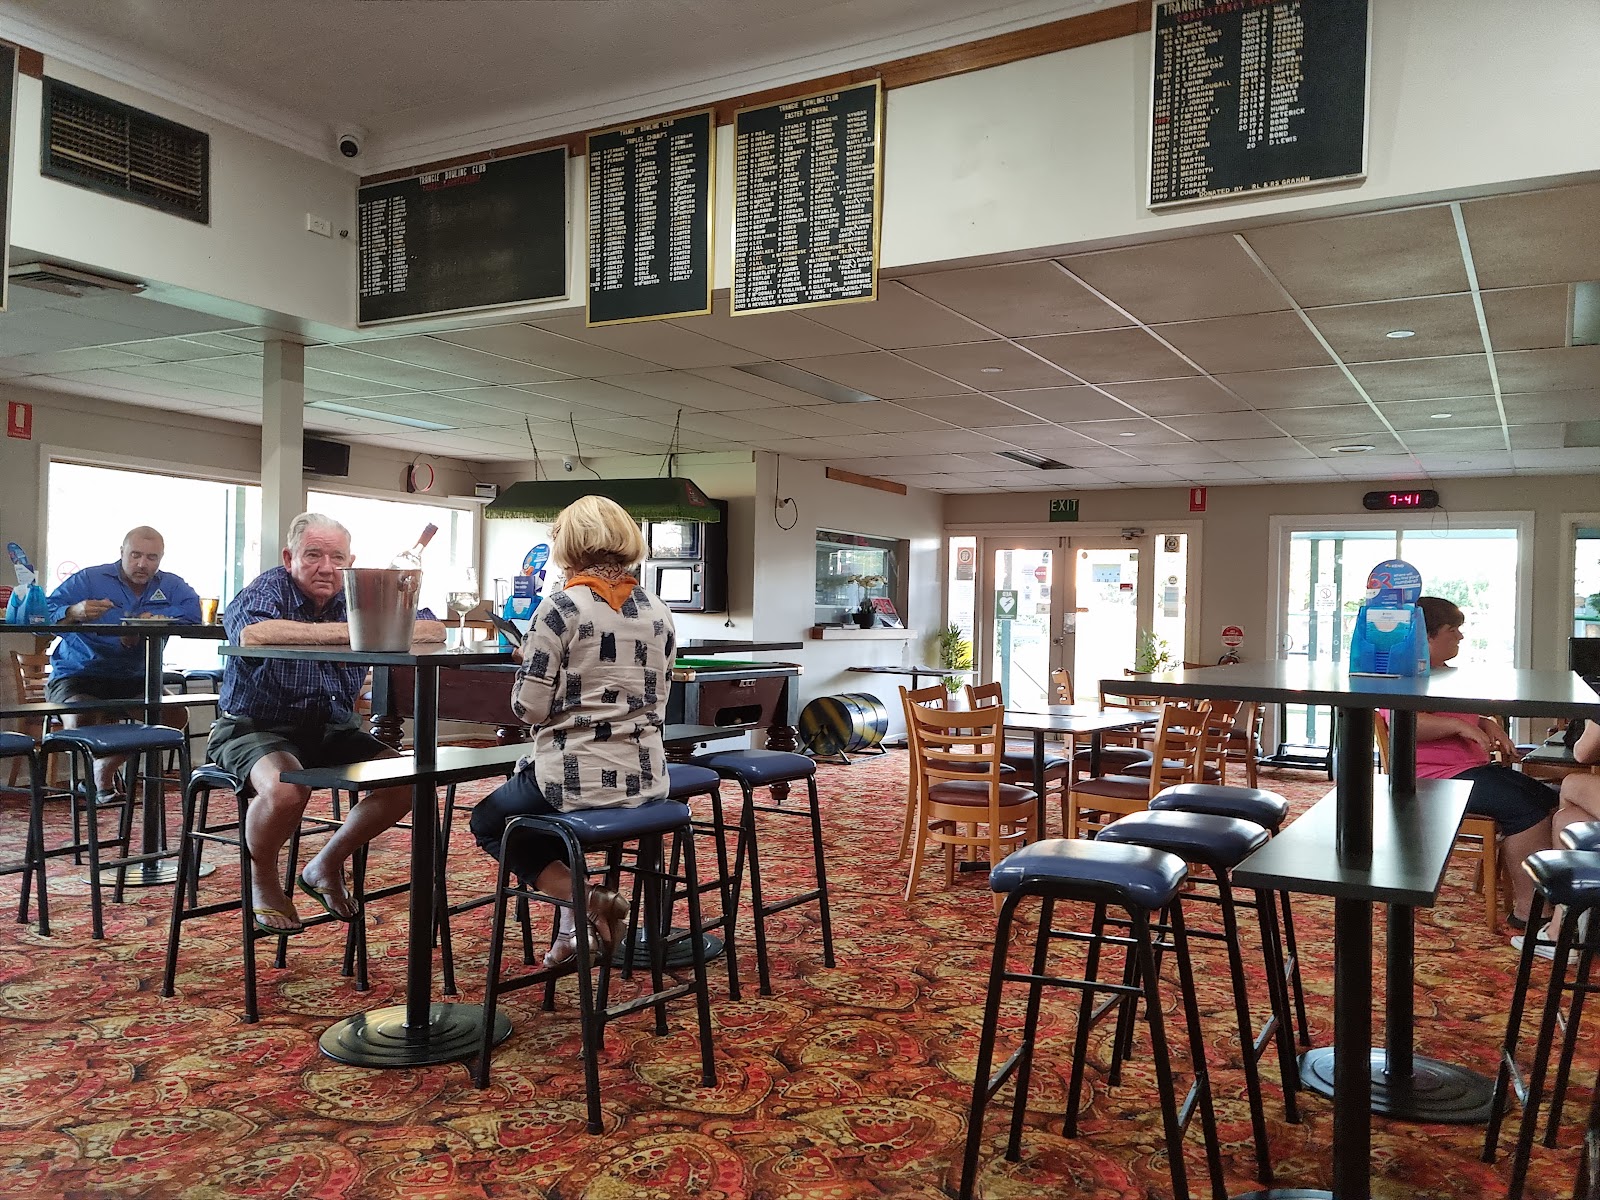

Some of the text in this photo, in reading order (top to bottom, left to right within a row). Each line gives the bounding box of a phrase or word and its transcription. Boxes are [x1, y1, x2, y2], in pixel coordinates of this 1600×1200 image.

[1271, 68, 1299, 79] CARTER
[1271, 74, 1303, 86] PHILLIPS
[1187, 79, 1230, 93] MACDOUGALL
[1271, 81, 1299, 92] CARTER
[1187, 89, 1214, 99] GRAHAM
[1270, 89, 1296, 99] HAINES
[802, 96, 825, 107] BOWLING
[826, 93, 839, 102] CLUB
[1187, 95, 1213, 106] JORDAN
[1270, 95, 1298, 106] HUGHES
[784, 104, 828, 119] EASTER CARNIVAL
[1180, 102, 1208, 113] FERRARI
[1269, 107, 1305, 119] HETERICK
[1270, 103, 1288, 112] HUME
[1180, 115, 1210, 126] COLEMAN
[1269, 116, 1289, 125] BOND
[1180, 122, 1208, 133] FERRARI
[1269, 123, 1288, 132] BOND
[1154, 129, 1205, 144] 1990 TURTON
[1269, 130, 1288, 139] BOND
[1275, 135, 1297, 144] LEWIS
[1154, 135, 1205, 150] 1991 TURTON
[1154, 148, 1169, 156] 1992
[1179, 141, 1210, 152] COLEMAN
[1153, 155, 1168, 163] 1993
[1153, 161, 1168, 169] 1994
[1180, 155, 1205, 164] MARTIN
[444, 168, 467, 179] BOWLING
[472, 164, 486, 174] CLUB
[1153, 167, 1168, 175] 1995
[1180, 161, 1205, 171] MARTIN
[1180, 166, 1213, 177] MEREDITH
[1152, 180, 1168, 188] 1997
[1180, 173, 1206, 183] COOPER
[1199, 187, 1229, 197] DONATED
[1281, 175, 1310, 185] GRAHAM
[1152, 186, 1167, 194] 1998
[1179, 179, 1208, 189] FERRARI
[1152, 193, 1167, 201] 1999
[1179, 186, 1206, 196] COOPER
[1051, 500, 1078, 512] EXIT
